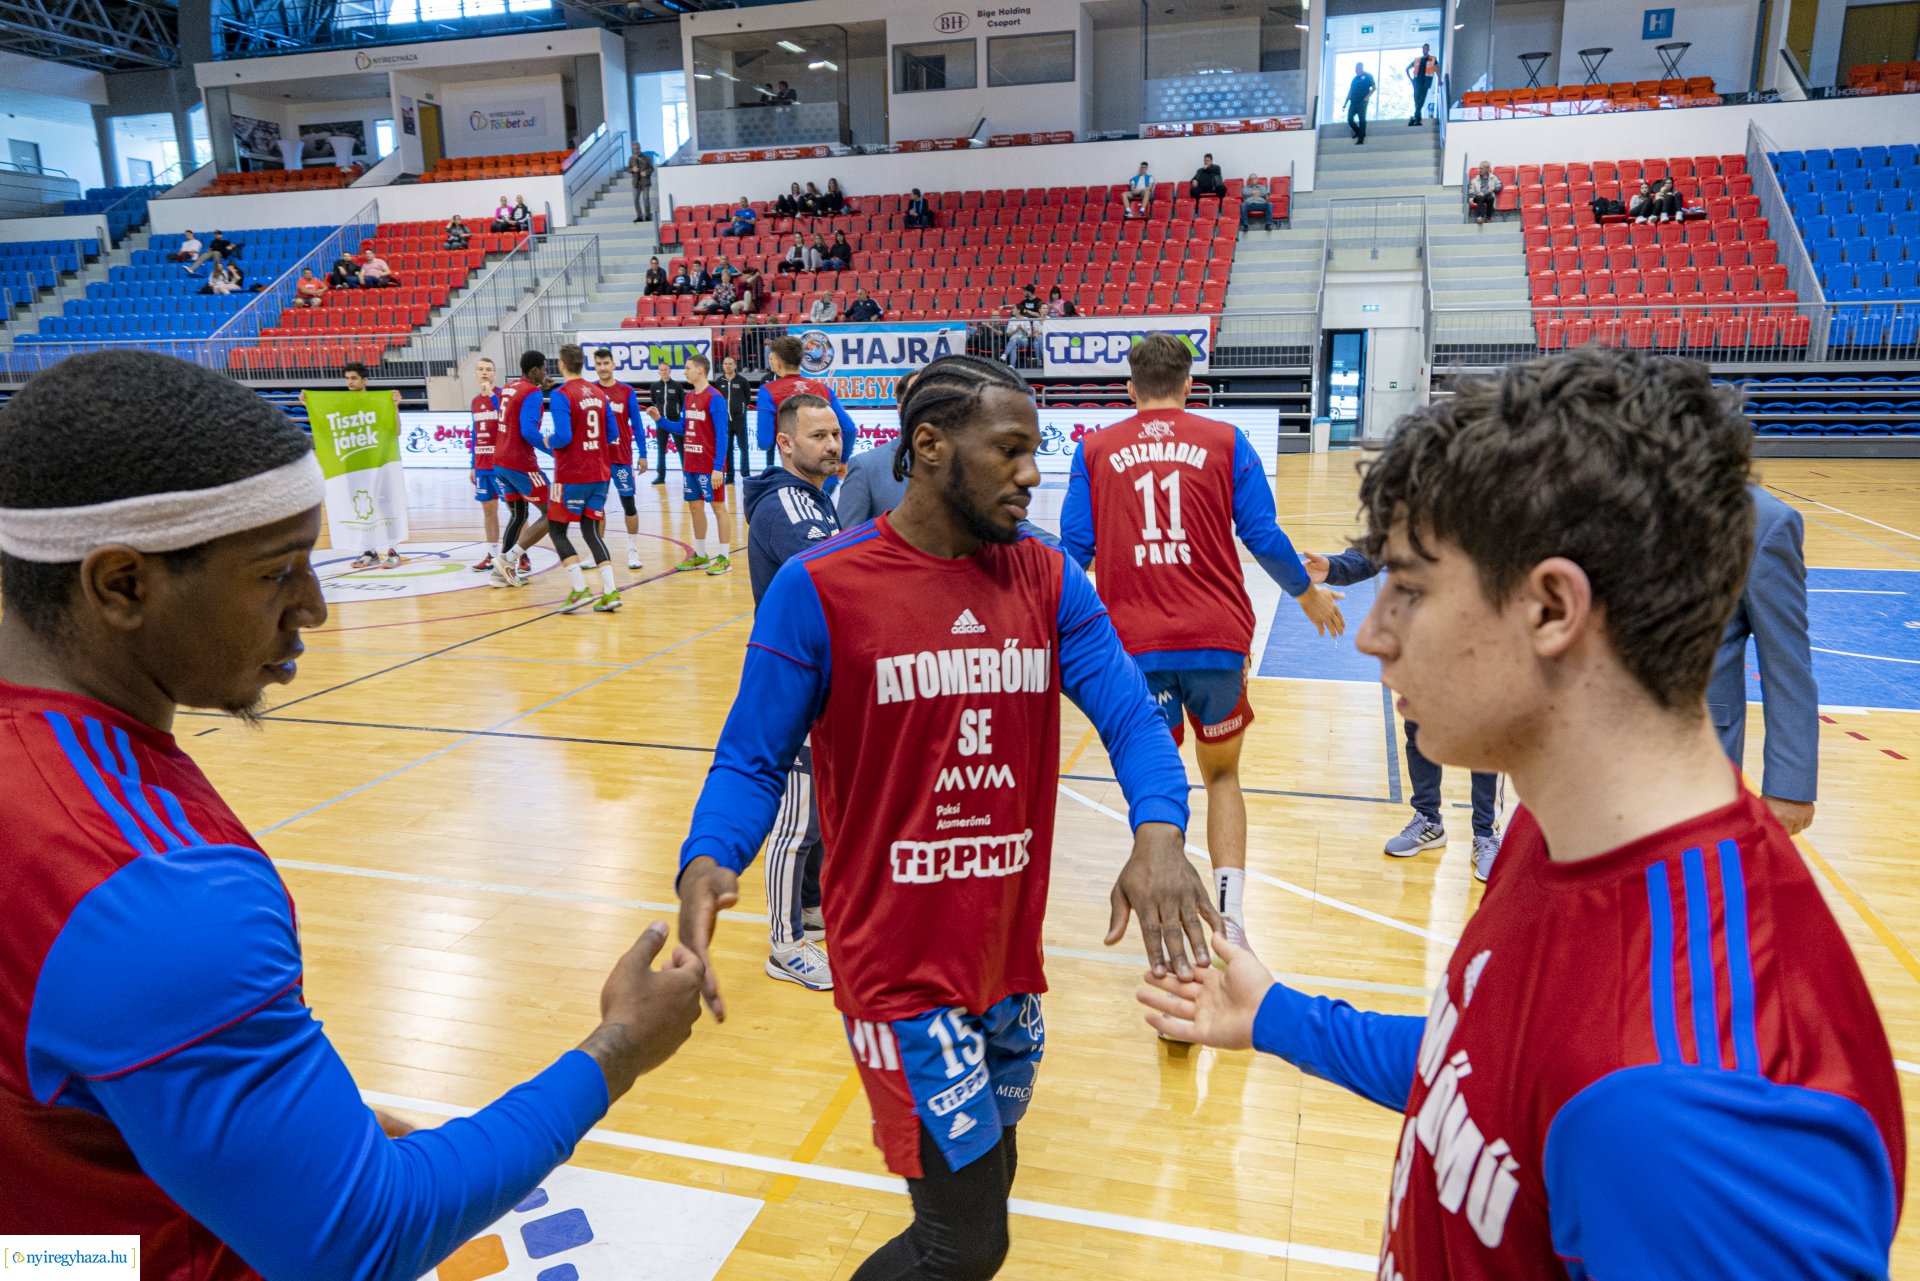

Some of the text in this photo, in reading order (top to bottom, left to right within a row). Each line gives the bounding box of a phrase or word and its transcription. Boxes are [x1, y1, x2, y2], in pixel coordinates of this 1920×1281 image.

[941, 15, 963, 30] BH
[977, 6, 1031, 18] Bige Holding
[987, 18, 1021, 28] Csoport
[841, 329, 952, 365] HAJRÁ
[326, 410, 377, 431] Tiszta
[587, 410, 599, 439] 9
[332, 425, 379, 456] játék
[1109, 441, 1208, 474] CSIZMADIA
[1134, 470, 1187, 541] 11
[1134, 542, 1192, 567] PAKS
[951, 624, 986, 634] adidas
[958, 708, 993, 757] SE
[934, 764, 1016, 793] MVM
[936, 802, 961, 817] Paksi
[936, 814, 991, 831] Atomerőmű
[927, 1006, 985, 1079] 15
